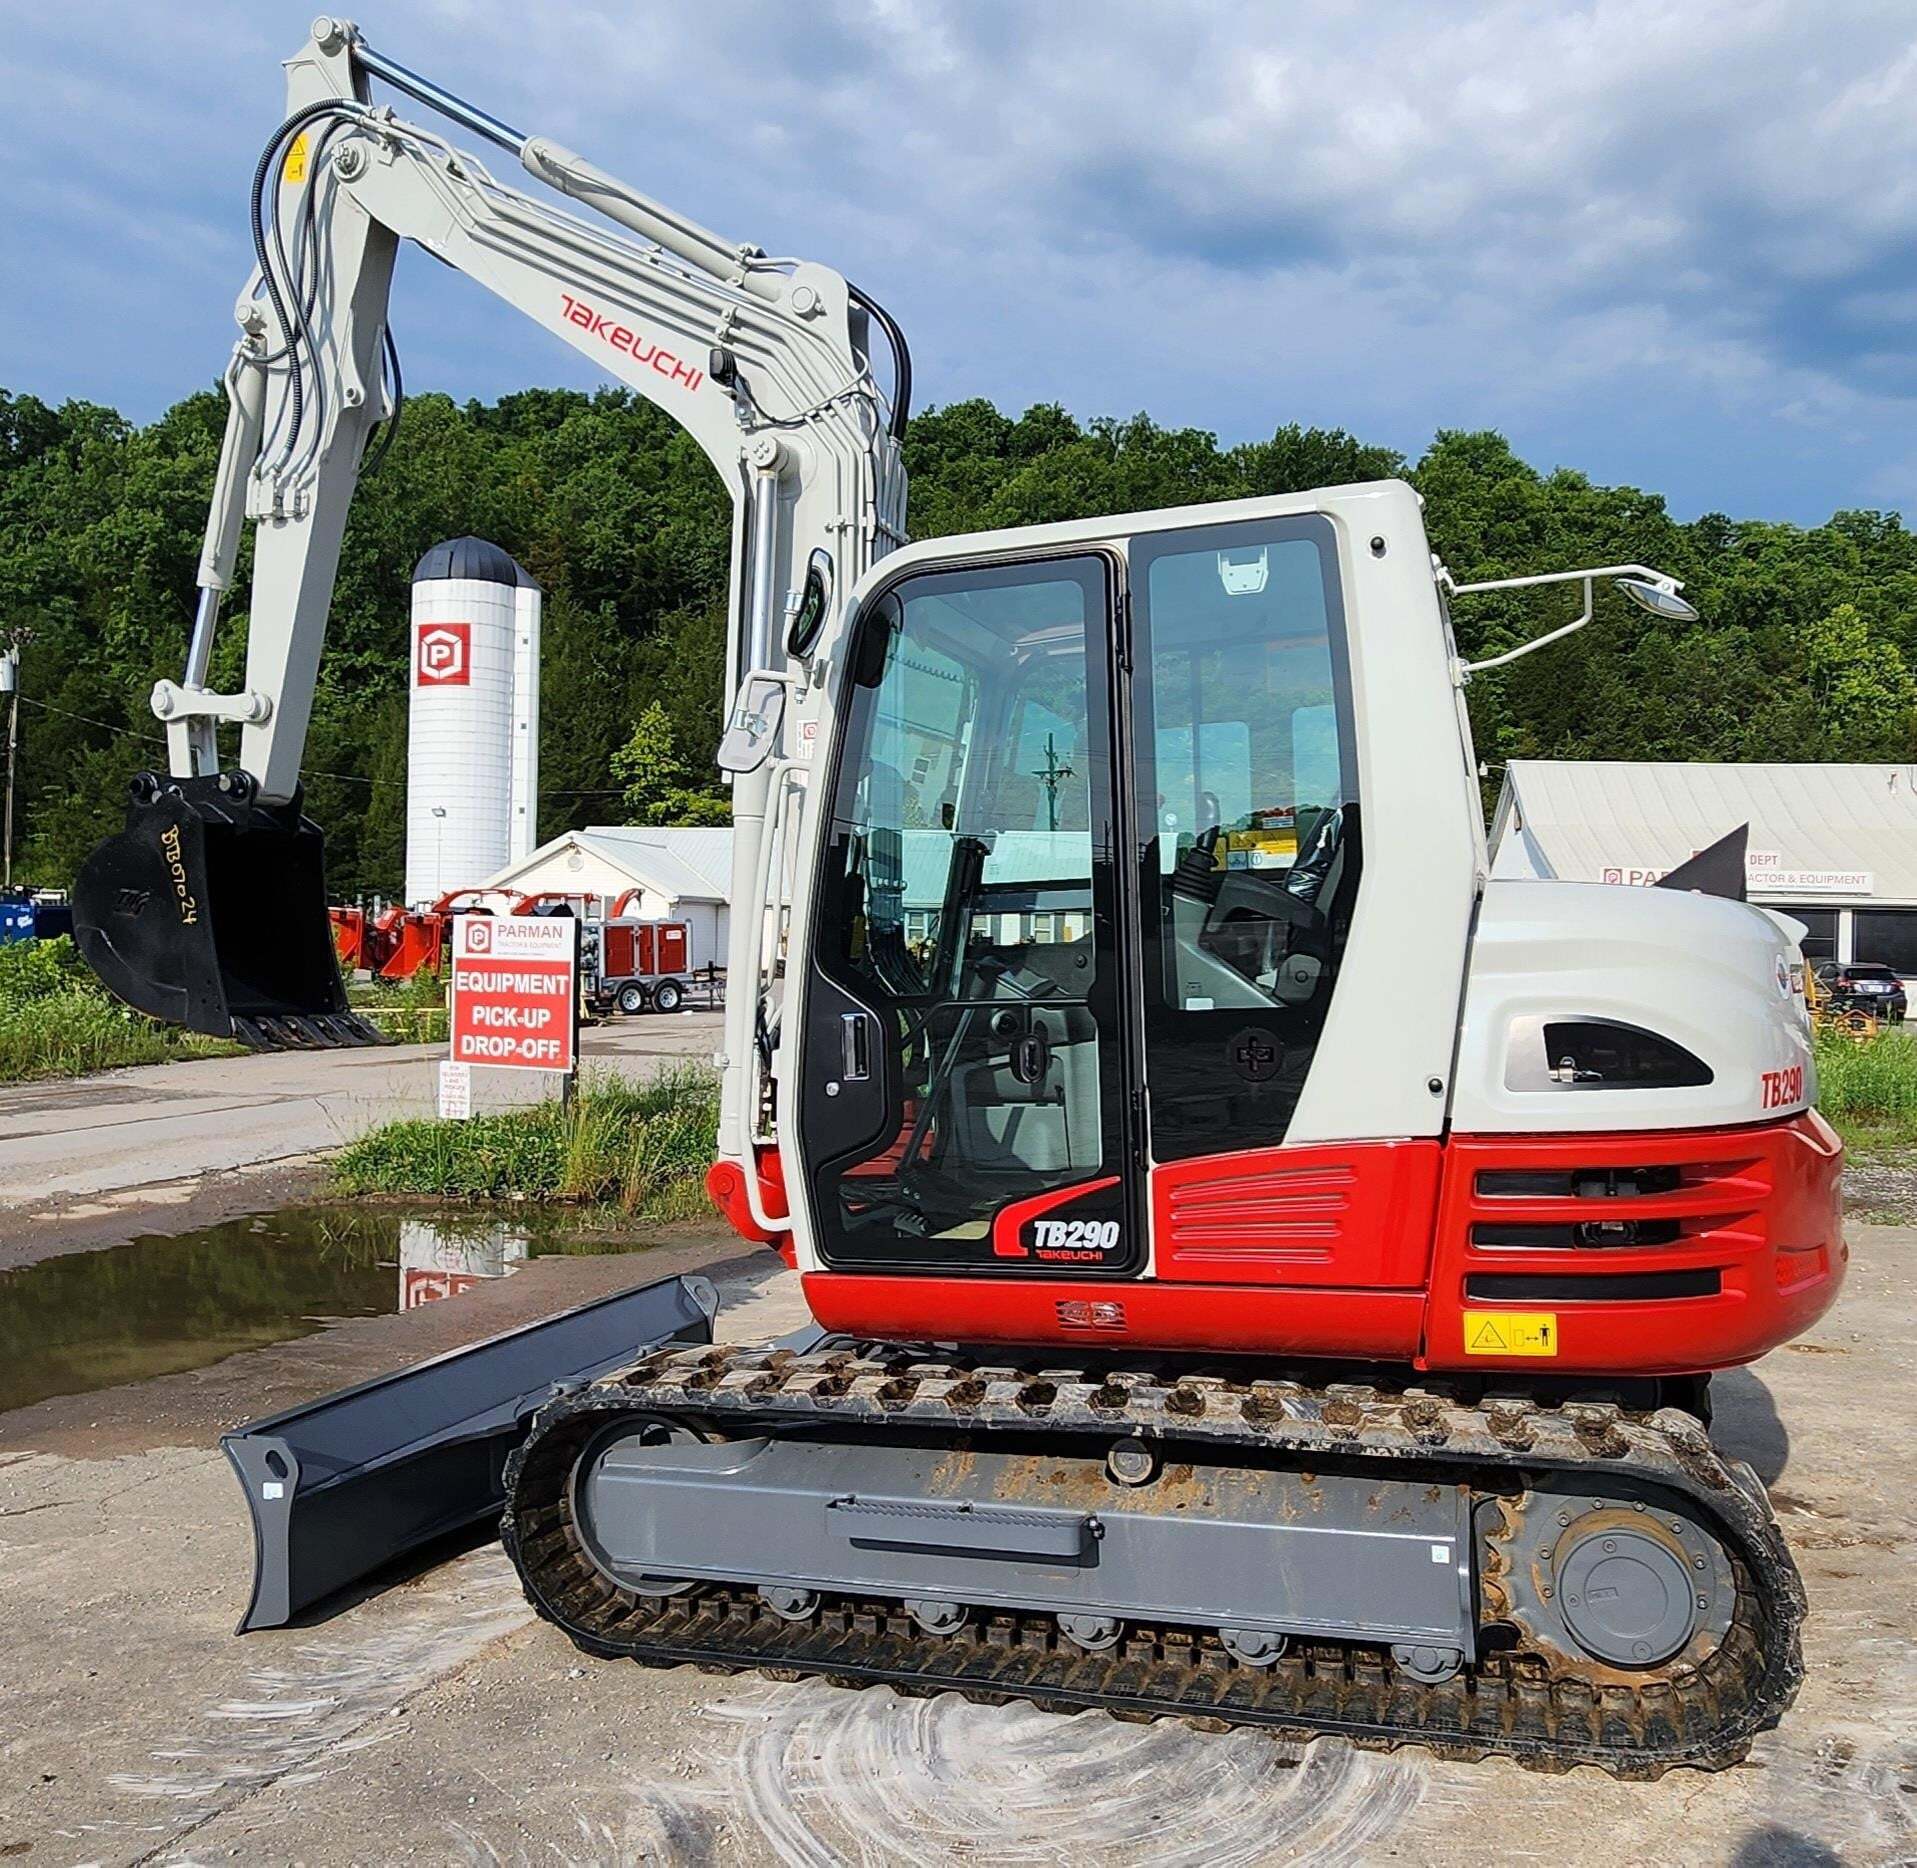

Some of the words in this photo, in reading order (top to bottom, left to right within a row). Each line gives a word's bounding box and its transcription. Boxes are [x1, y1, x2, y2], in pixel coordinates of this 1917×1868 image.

[431, 645, 450, 665] P
[1750, 855, 1778, 865] DEPT
[1748, 874, 1785, 883] ACTOR
[1789, 874, 1796, 883] &
[1800, 875, 1867, 884] EQUIPMENT
[498, 925, 562, 938] PARMAN
[456, 971, 569, 995] EQUIPMENT
[472, 1005, 551, 1029] PICK-UP
[461, 1034, 561, 1060] DROP-OFF
[1762, 1066, 1802, 1109] TB290
[1034, 1220, 1120, 1249] TB290
